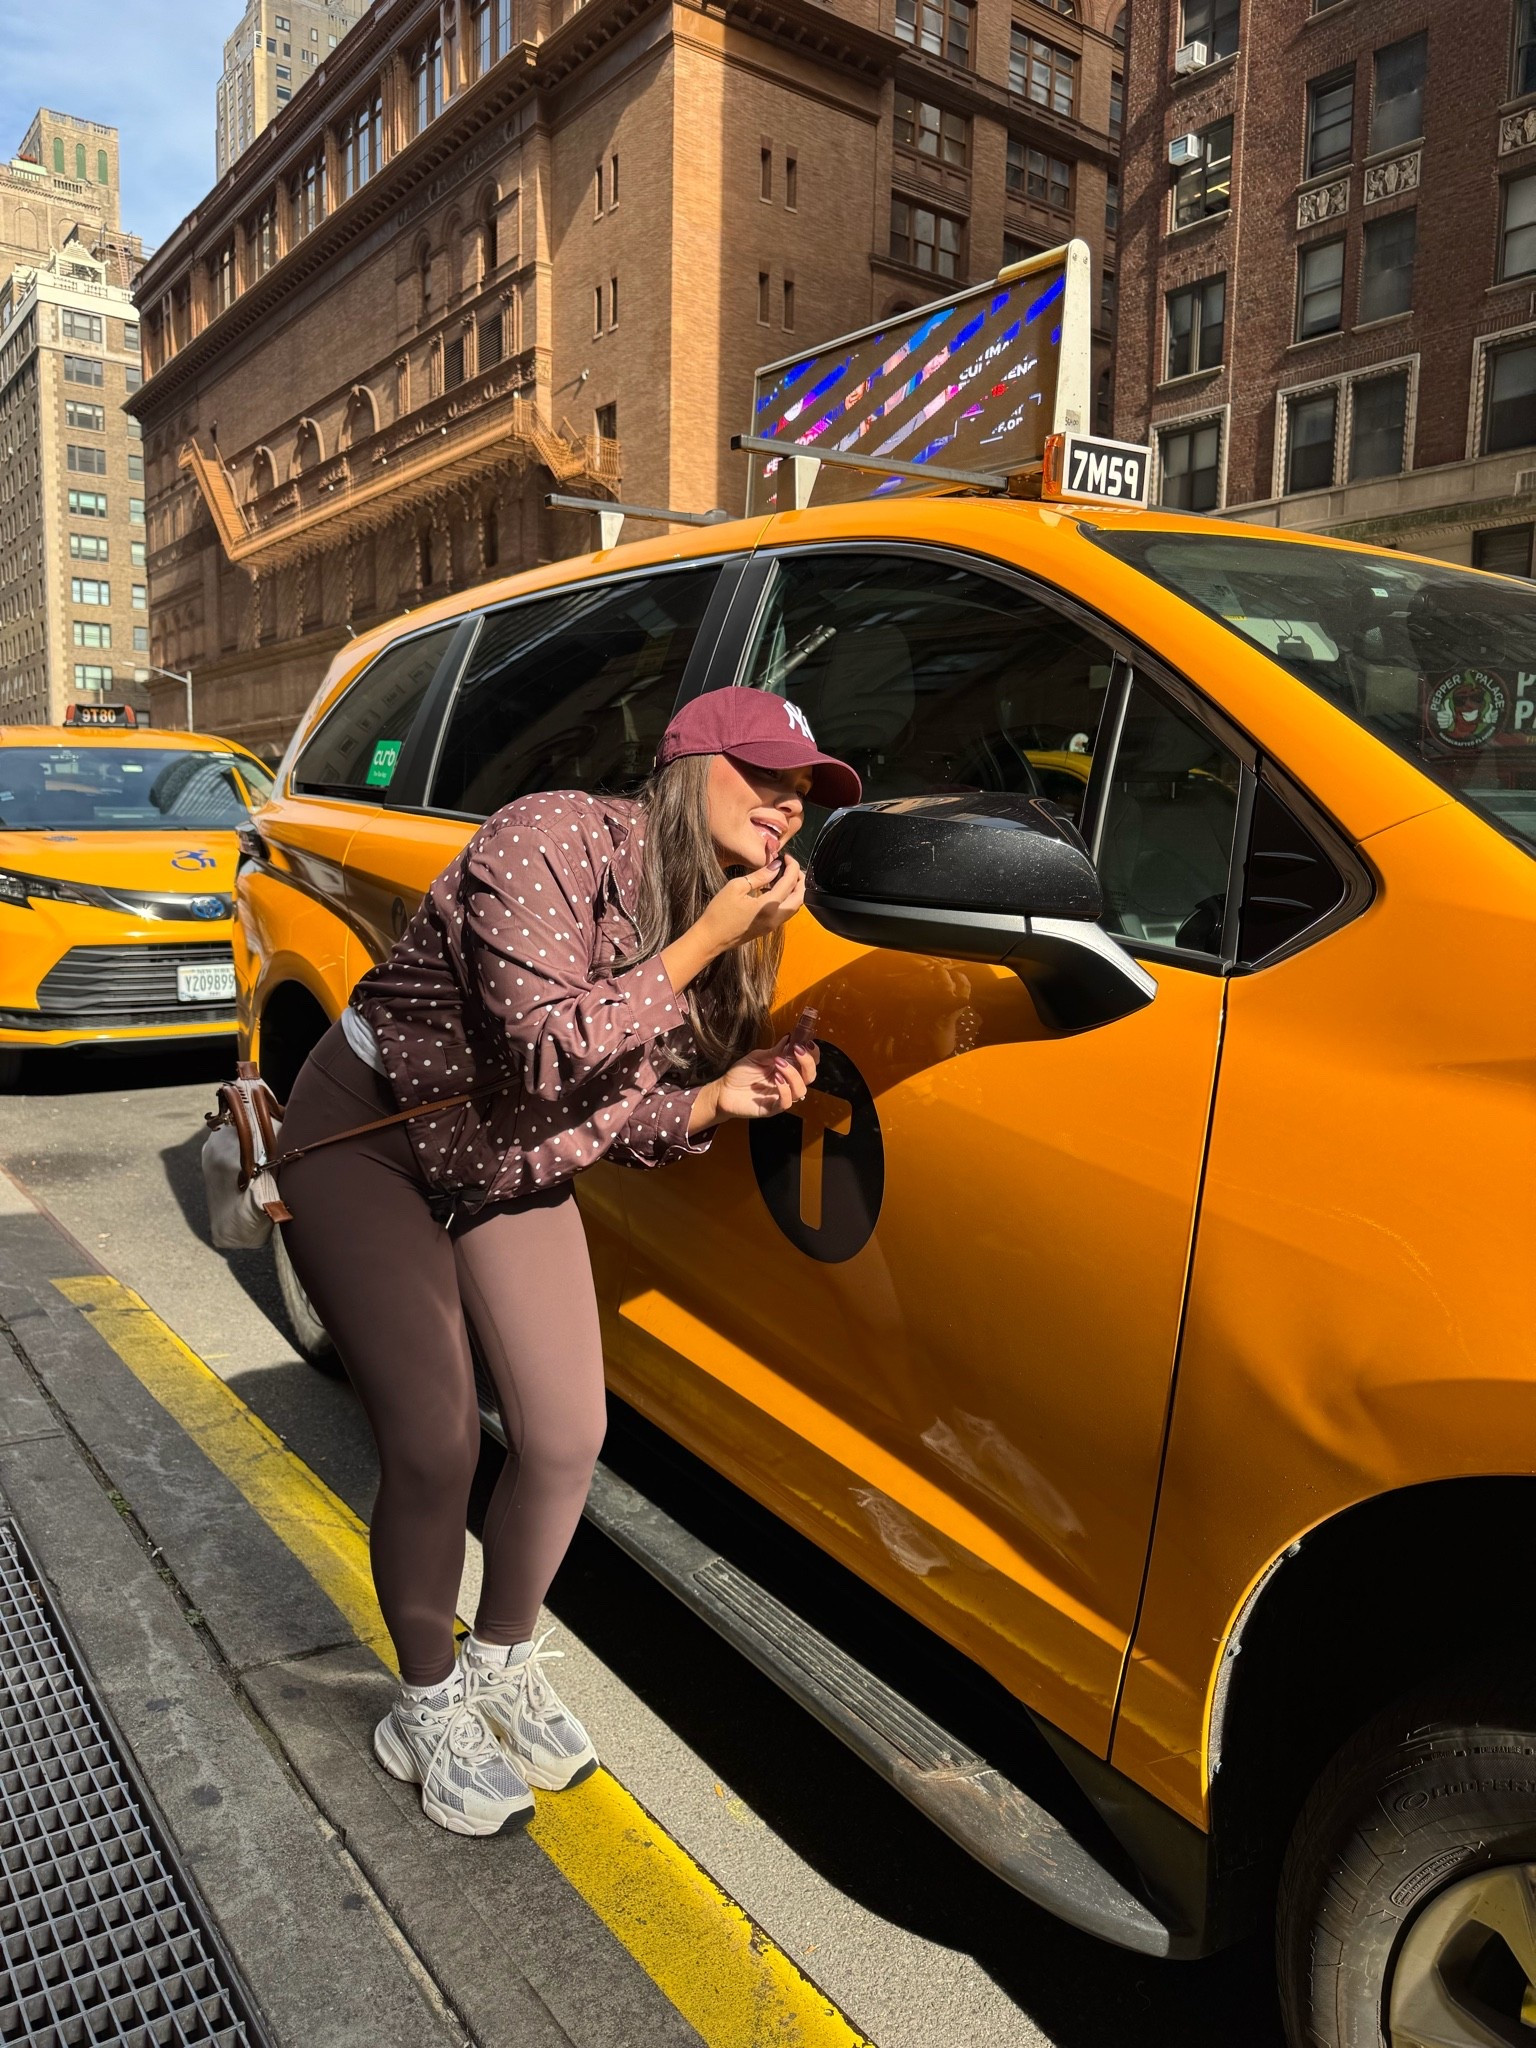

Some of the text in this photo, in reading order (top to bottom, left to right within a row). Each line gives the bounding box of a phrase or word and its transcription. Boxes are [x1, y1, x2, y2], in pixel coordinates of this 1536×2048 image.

[1071, 449, 1139, 499] 7M59
[1430, 674, 1461, 711] PEPPER
[1475, 672, 1505, 709] PALACE
[82, 708, 116, 723] 9T80
[784, 1086, 853, 1231] T
